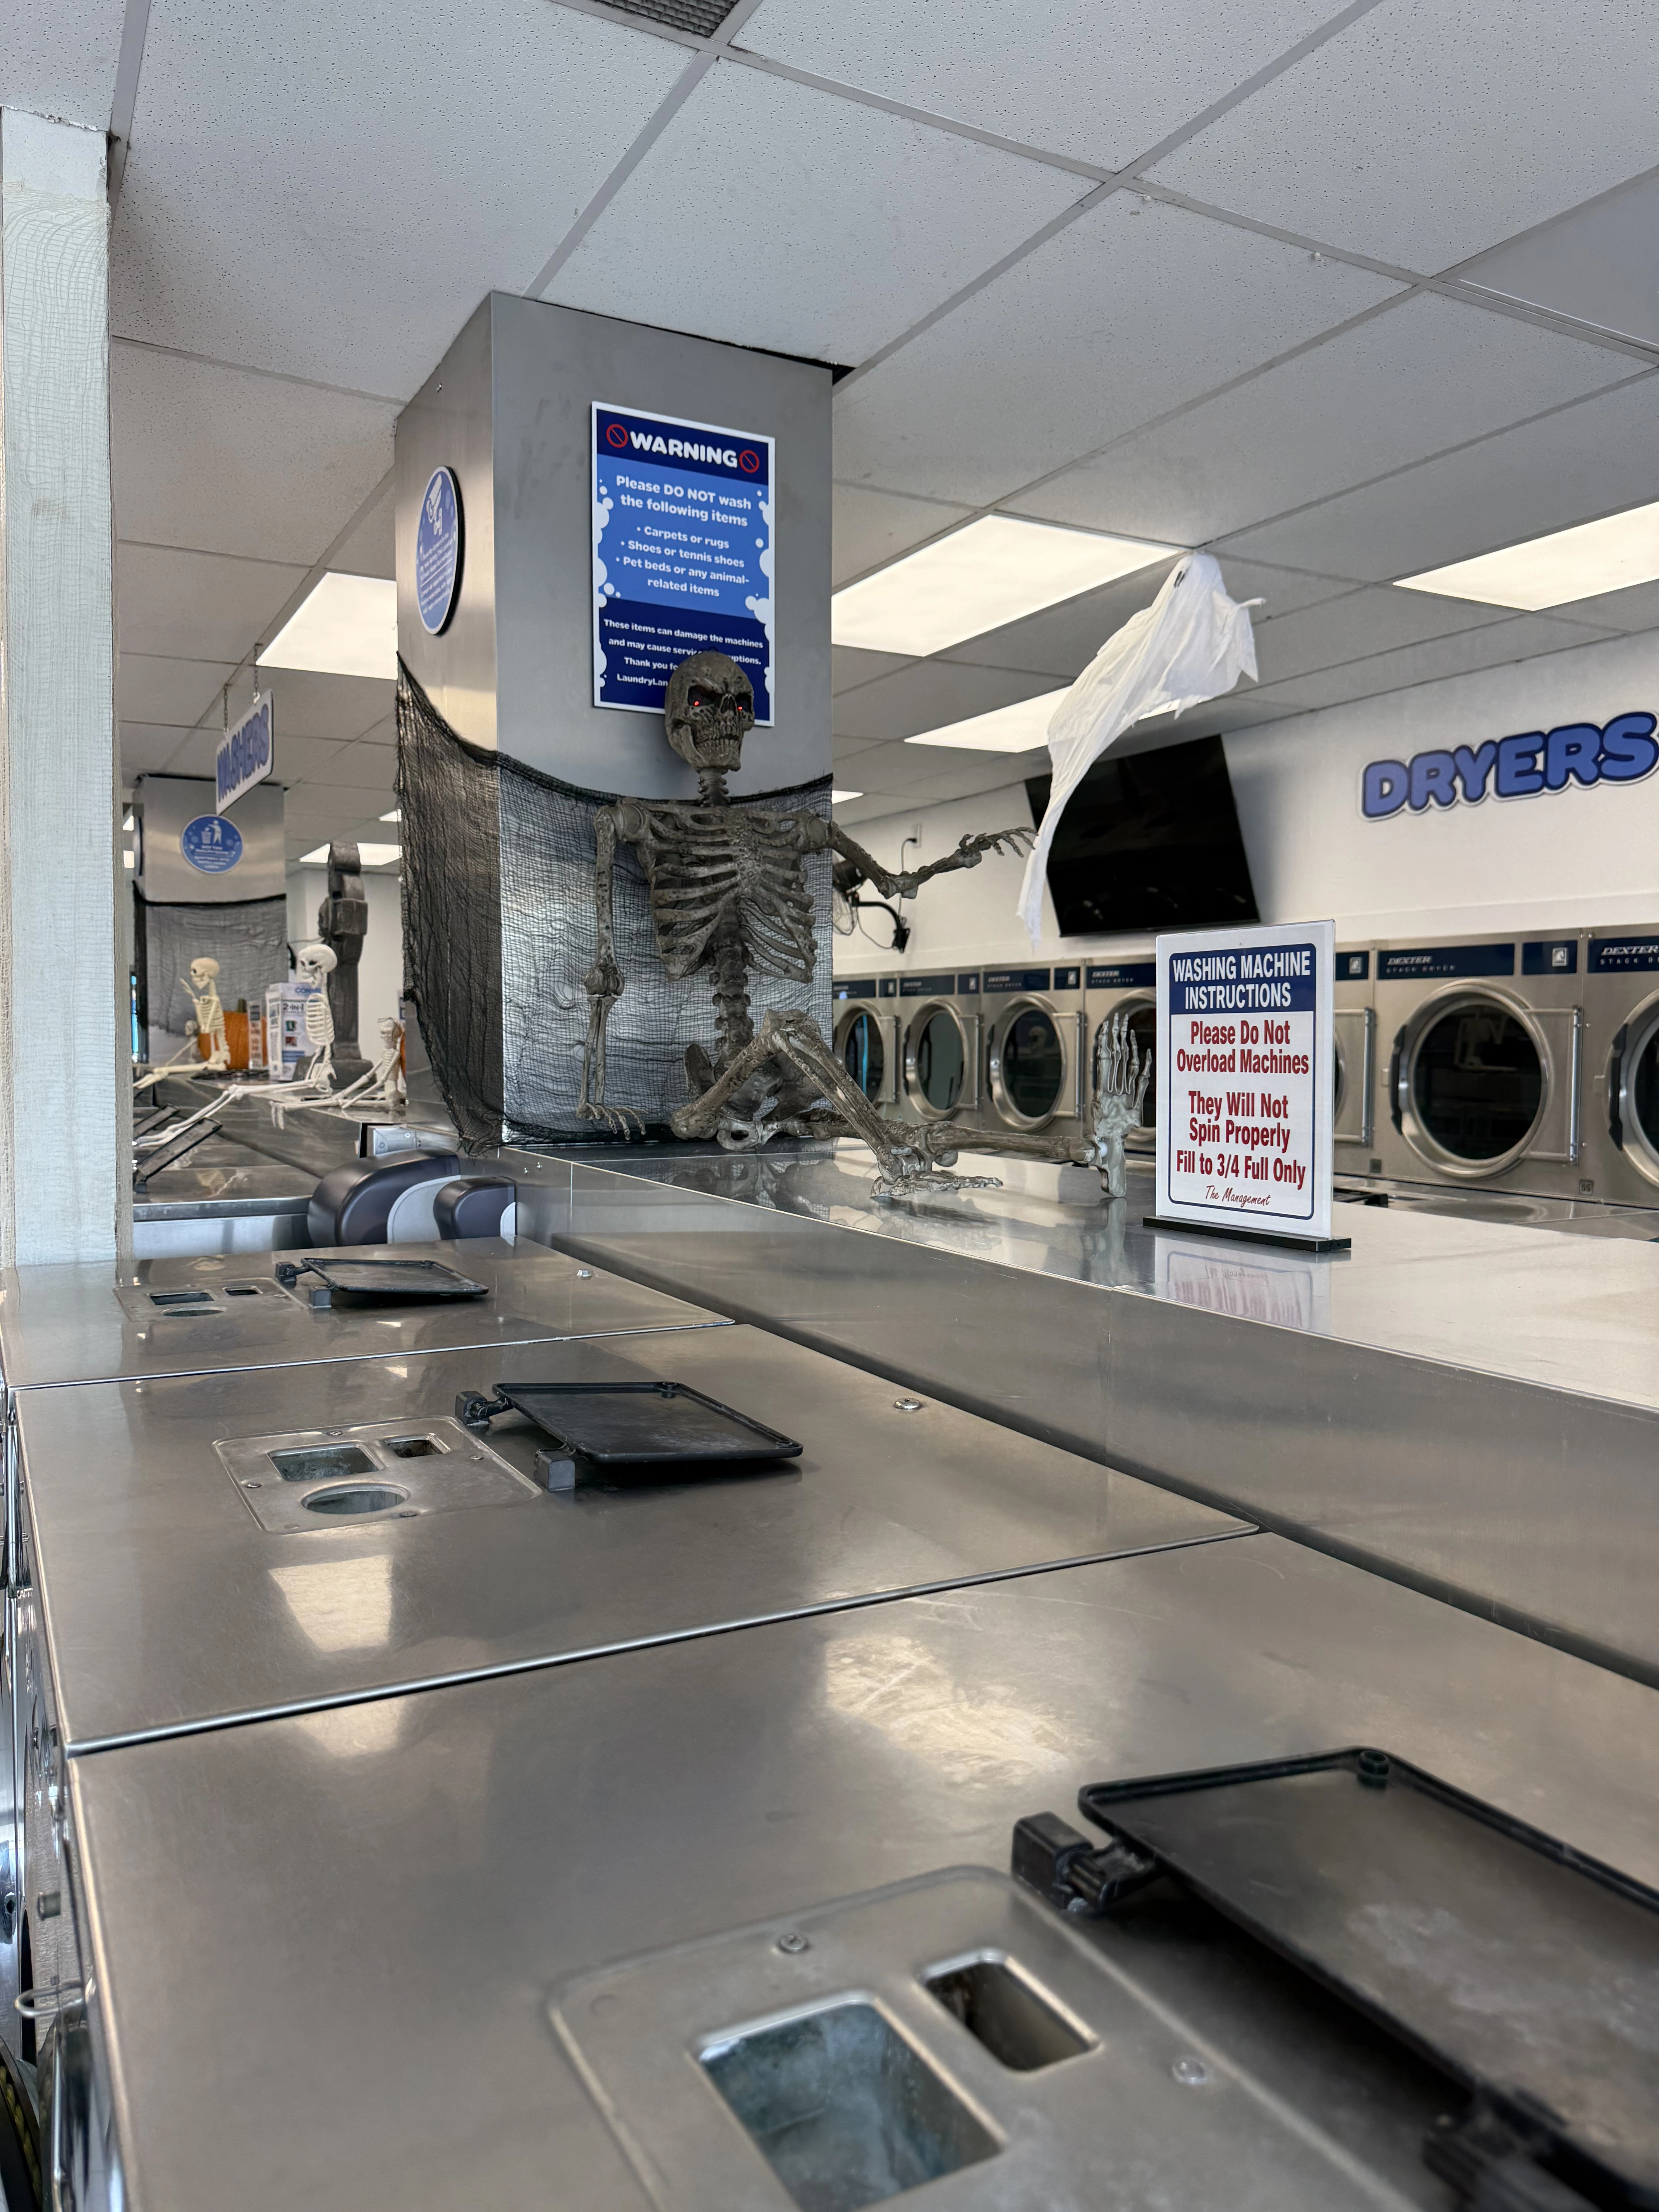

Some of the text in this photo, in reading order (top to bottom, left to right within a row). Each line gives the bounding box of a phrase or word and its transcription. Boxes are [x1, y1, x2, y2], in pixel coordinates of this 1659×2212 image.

[630, 431, 738, 468] WARNING
[617, 475, 751, 510] Please DO NOT wash
[620, 494, 748, 527] the following items
[644, 526, 729, 549] Carpets or rugs
[628, 540, 744, 568] Shoes or tennis shoes
[623, 556, 749, 584] Pet beds or any animal-
[648, 579, 720, 596] related items
[604, 619, 763, 648] These items can damage the machines
[609, 638, 761, 665] and may cause servi ptions.
[624, 657, 678, 670] Thank you fo
[617, 674, 668, 687] LaundryLan
[217, 703, 270, 803] WASHERS
[1362, 712, 1659, 818] DRYERS
[1387, 956, 1432, 965] DEXTER
[1601, 945, 1659, 956] DEXTER
[1173, 951, 1310, 982] WASHING MACHINE
[1185, 982, 1291, 1010] INSTRUCTIONS
[1191, 1020, 1290, 1044] Please Do Not
[1177, 1048, 1309, 1074] Overload Machines
[1188, 1091, 1288, 1121] They Will Not
[1189, 1117, 1290, 1154] Spin Properly
[1176, 1150, 1306, 1190] Fill to 3/4 Full Only
[1205, 1185, 1271, 1207] The Management
